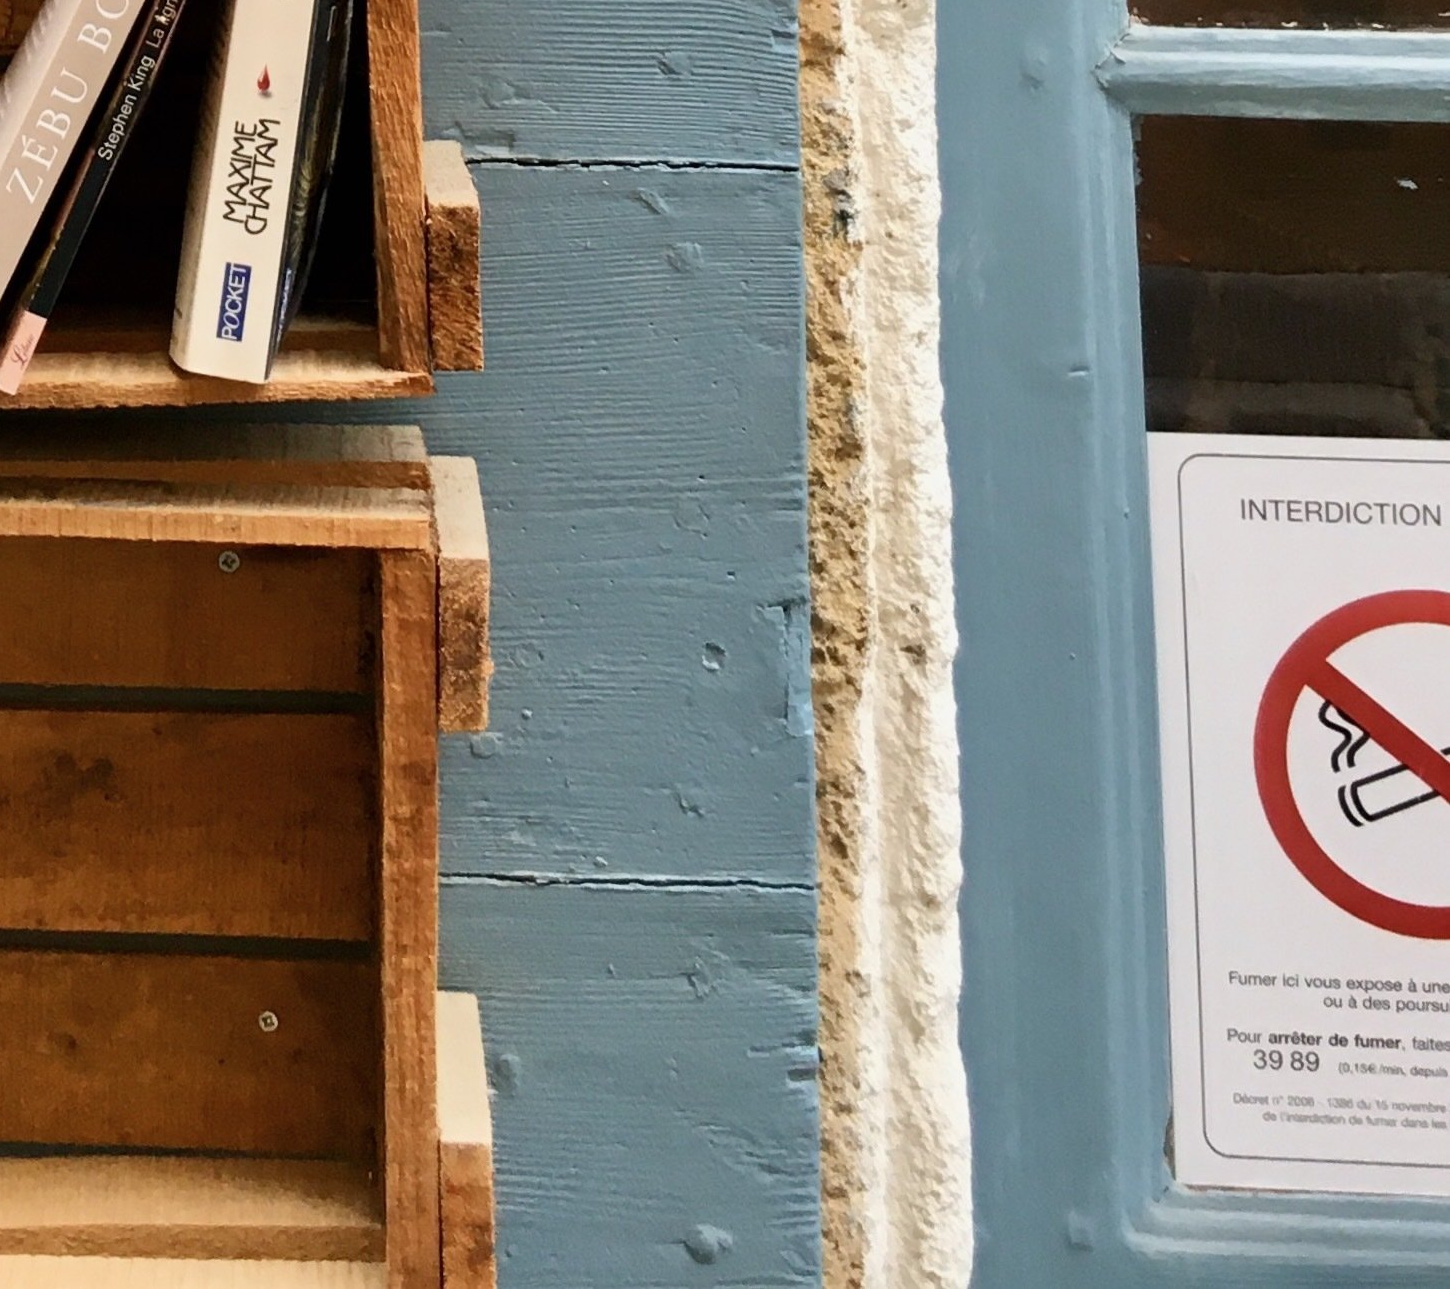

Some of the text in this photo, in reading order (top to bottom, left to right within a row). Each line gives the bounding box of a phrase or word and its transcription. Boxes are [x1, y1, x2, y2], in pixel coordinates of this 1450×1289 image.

[97, 95, 138, 161] Stephen
[127, 55, 156, 92] King
[146, 27, 164, 48] La
[6, 67, 88, 204] ZÉBU
[223, 120, 257, 224] MAXIME
[243, 118, 281, 235] CHATTAM
[221, 263, 248, 341] POCKET
[1241, 498, 1442, 526] INTERDICTION
[1228, 971, 1450, 994] Fumer ici vous expose à une
[1323, 996, 1342, 1008] ou
[1349, 995, 1357, 1009] à
[1363, 996, 1390, 1010] des
[1227, 1028, 1261, 1044] Pour
[1268, 1031, 1322, 1046] arrêter
[1329, 1033, 1348, 1047] de
[1253, 1049, 1284, 1070] 39
[1290, 1051, 1320, 1072] 89
